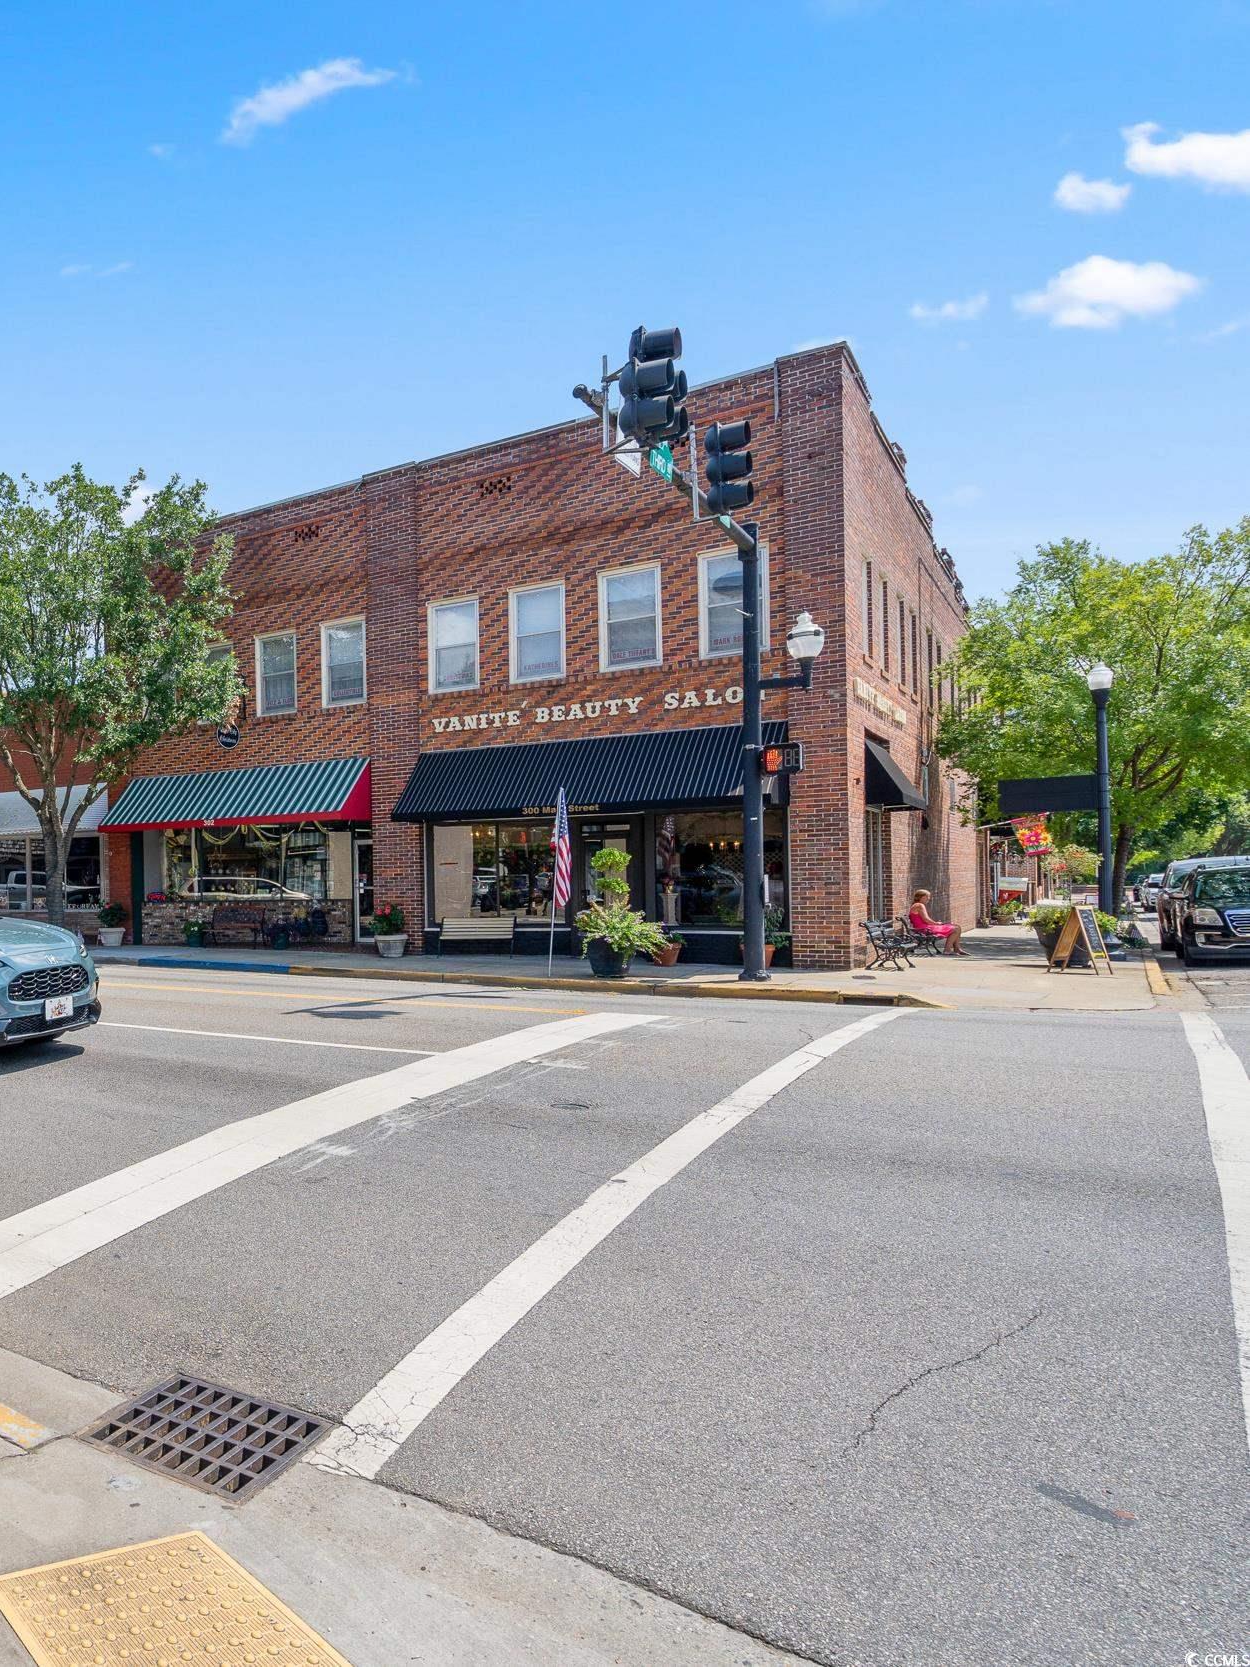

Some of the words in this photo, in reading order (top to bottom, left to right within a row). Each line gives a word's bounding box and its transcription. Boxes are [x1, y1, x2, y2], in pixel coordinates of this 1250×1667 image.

[535, 697, 644, 722] BEAUTY
[664, 686, 766, 709] SALO
[522, 807, 540, 815] 300
[568, 804, 600, 812] Street
